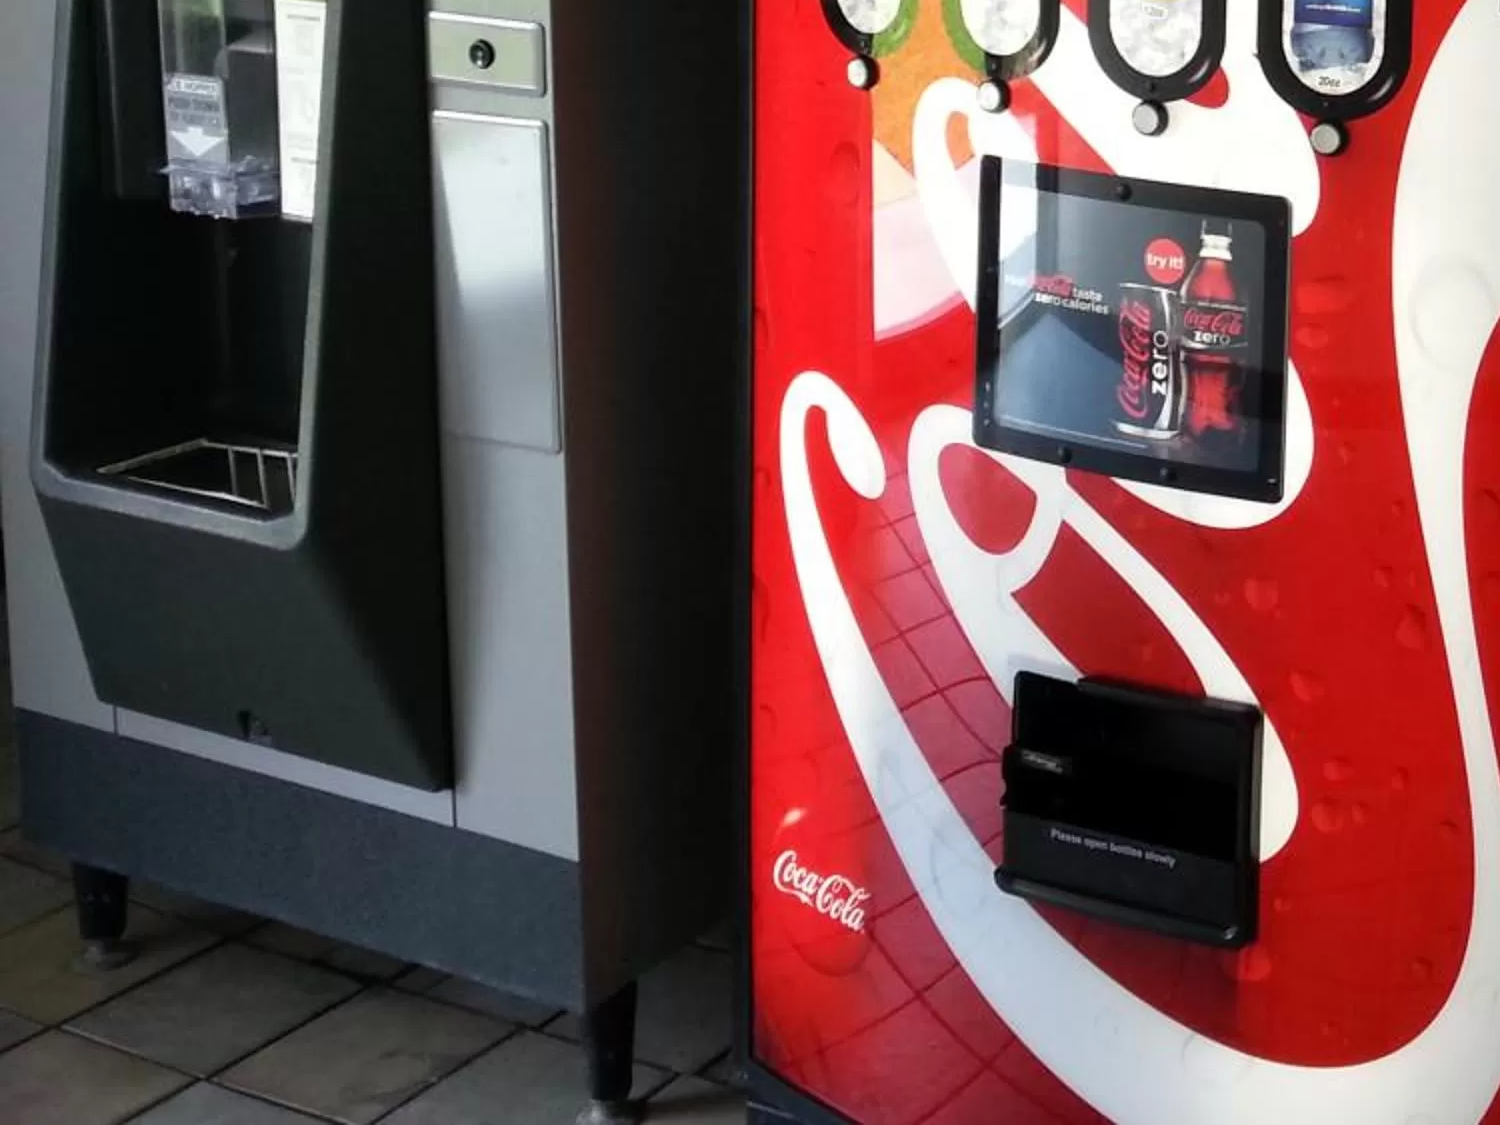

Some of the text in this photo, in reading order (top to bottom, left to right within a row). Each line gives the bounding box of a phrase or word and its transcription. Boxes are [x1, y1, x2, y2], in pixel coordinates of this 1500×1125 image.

[1146, 252, 1168, 270] try
[1193, 330, 1231, 345] zero
[1151, 330, 1169, 396] zero
[1051, 828, 1081, 844] Please
[1144, 850, 1176, 869] slowly
